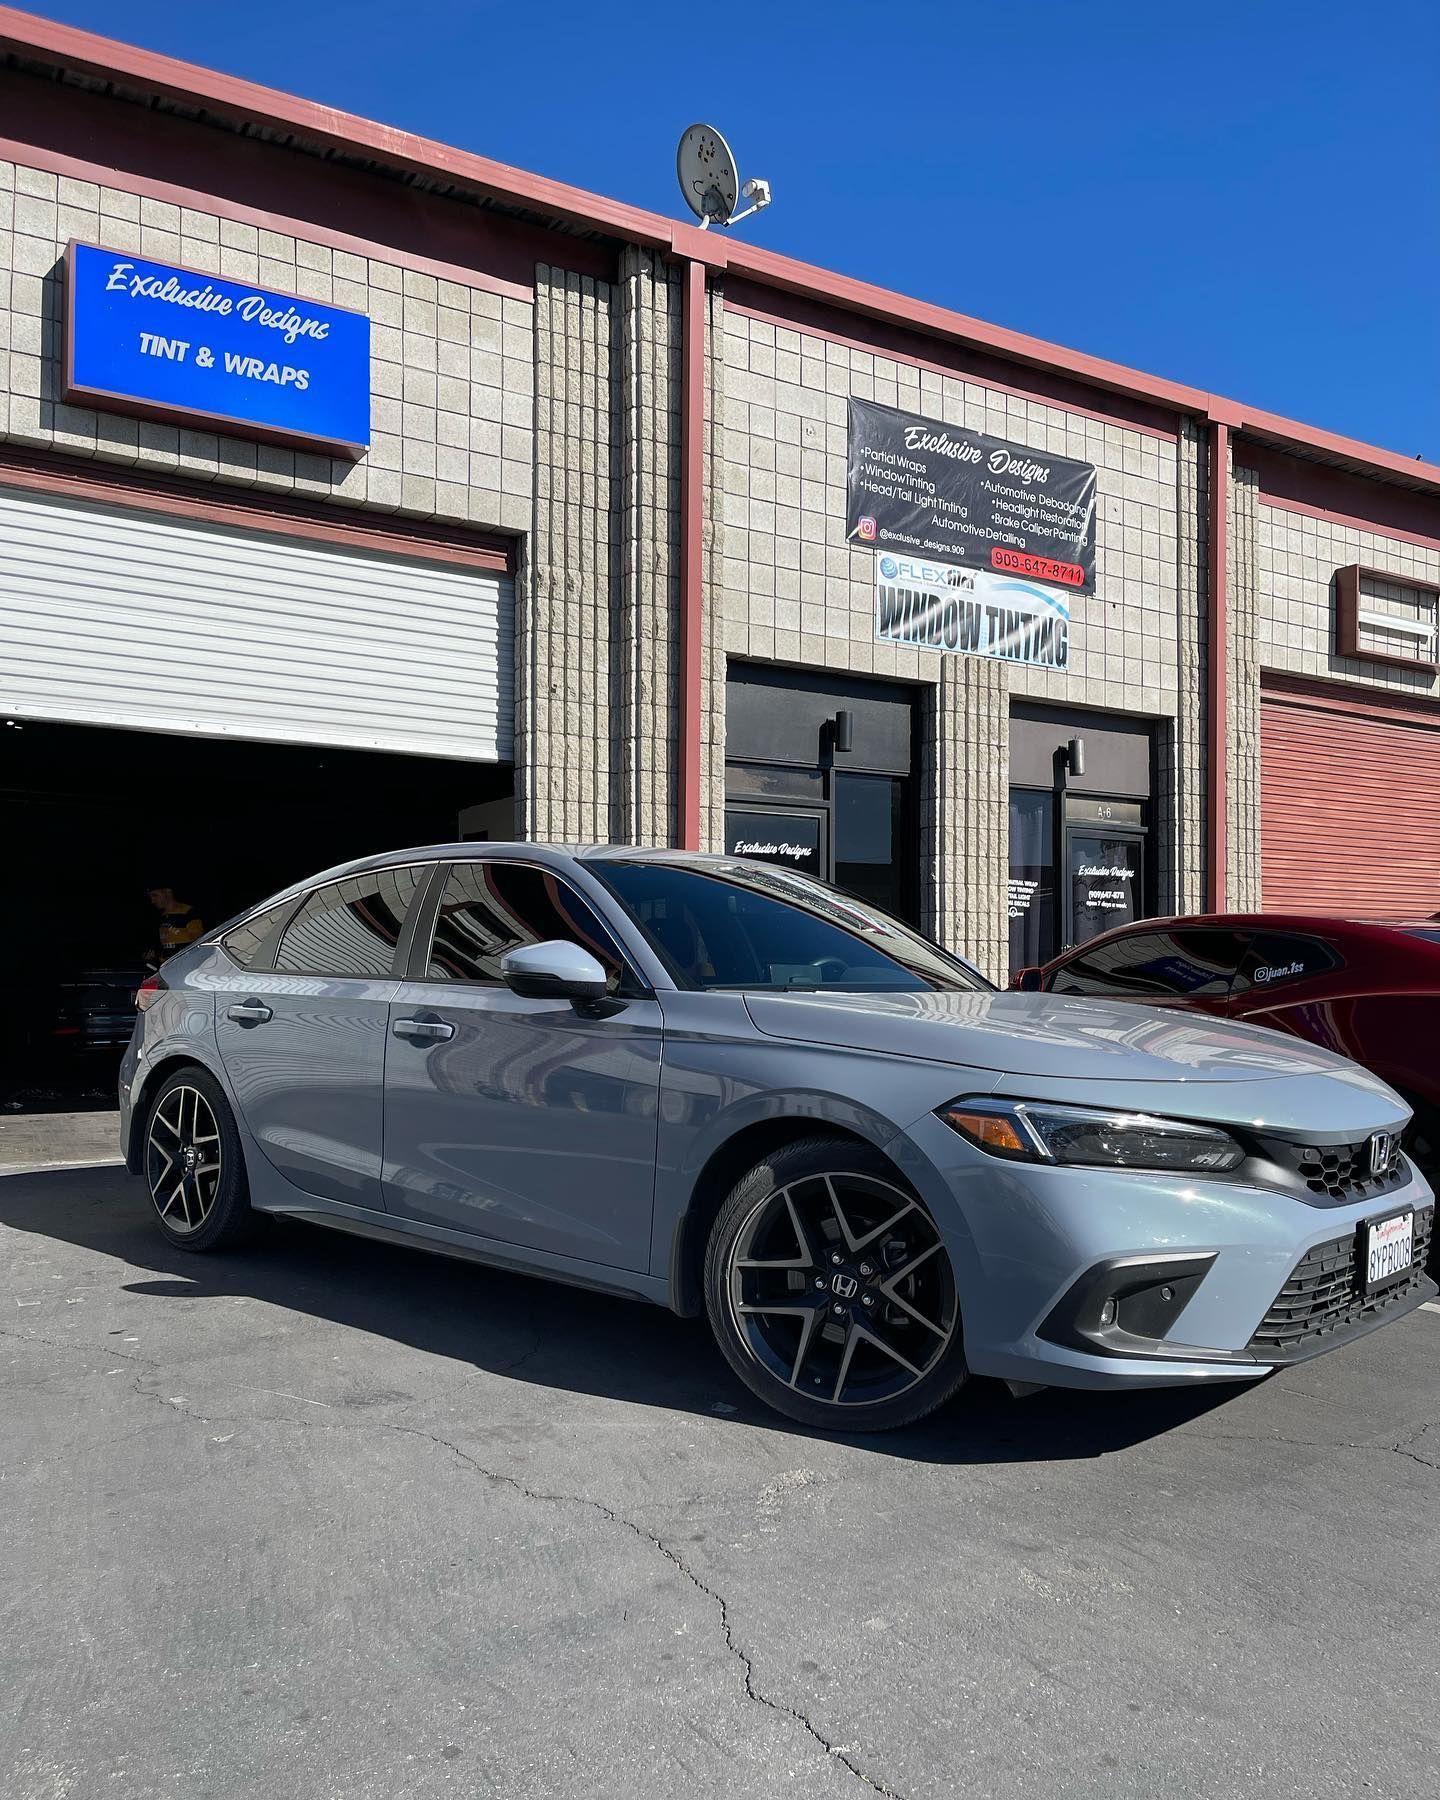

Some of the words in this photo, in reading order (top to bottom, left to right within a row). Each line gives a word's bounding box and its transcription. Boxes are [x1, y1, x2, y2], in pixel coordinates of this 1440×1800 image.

[106, 263, 232, 316] Exclusive
[236, 296, 330, 344] Designs
[139, 332, 190, 362] TINT
[195, 346, 216, 368] &
[224, 352, 310, 390] WRAPS
[864, 446, 896, 466] Partial
[896, 455, 927, 474] Wraps
[904, 426, 983, 464] Exclusive
[987, 449, 1050, 485] Designs
[864, 462, 906, 484] Window
[905, 473, 936, 494] Tinting
[864, 478, 912, 502] Head/Tail
[914, 492, 938, 508] Light
[937, 498, 968, 518] Tinting
[984, 479, 1037, 503] Automotive
[1039, 493, 1088, 518] Debadging
[995, 497, 1040, 519] Headlight
[1040, 509, 1087, 533] Restoration
[879, 528, 965, 556] @exclusive_designs.909
[931, 514, 986, 537] Automotive
[985, 528, 1026, 549] Detailing
[994, 512, 1020, 529] Brake
[1020, 520, 1053, 537] Caliper
[1053, 527, 1088, 547] Painting
[995, 551, 1082, 582] 909-647-8711
[879, 584, 982, 651] WINDOW
[985, 605, 1068, 668] TINTING
[734, 840, 778, 855] Exclusive
[777, 842, 812, 860] Designs
